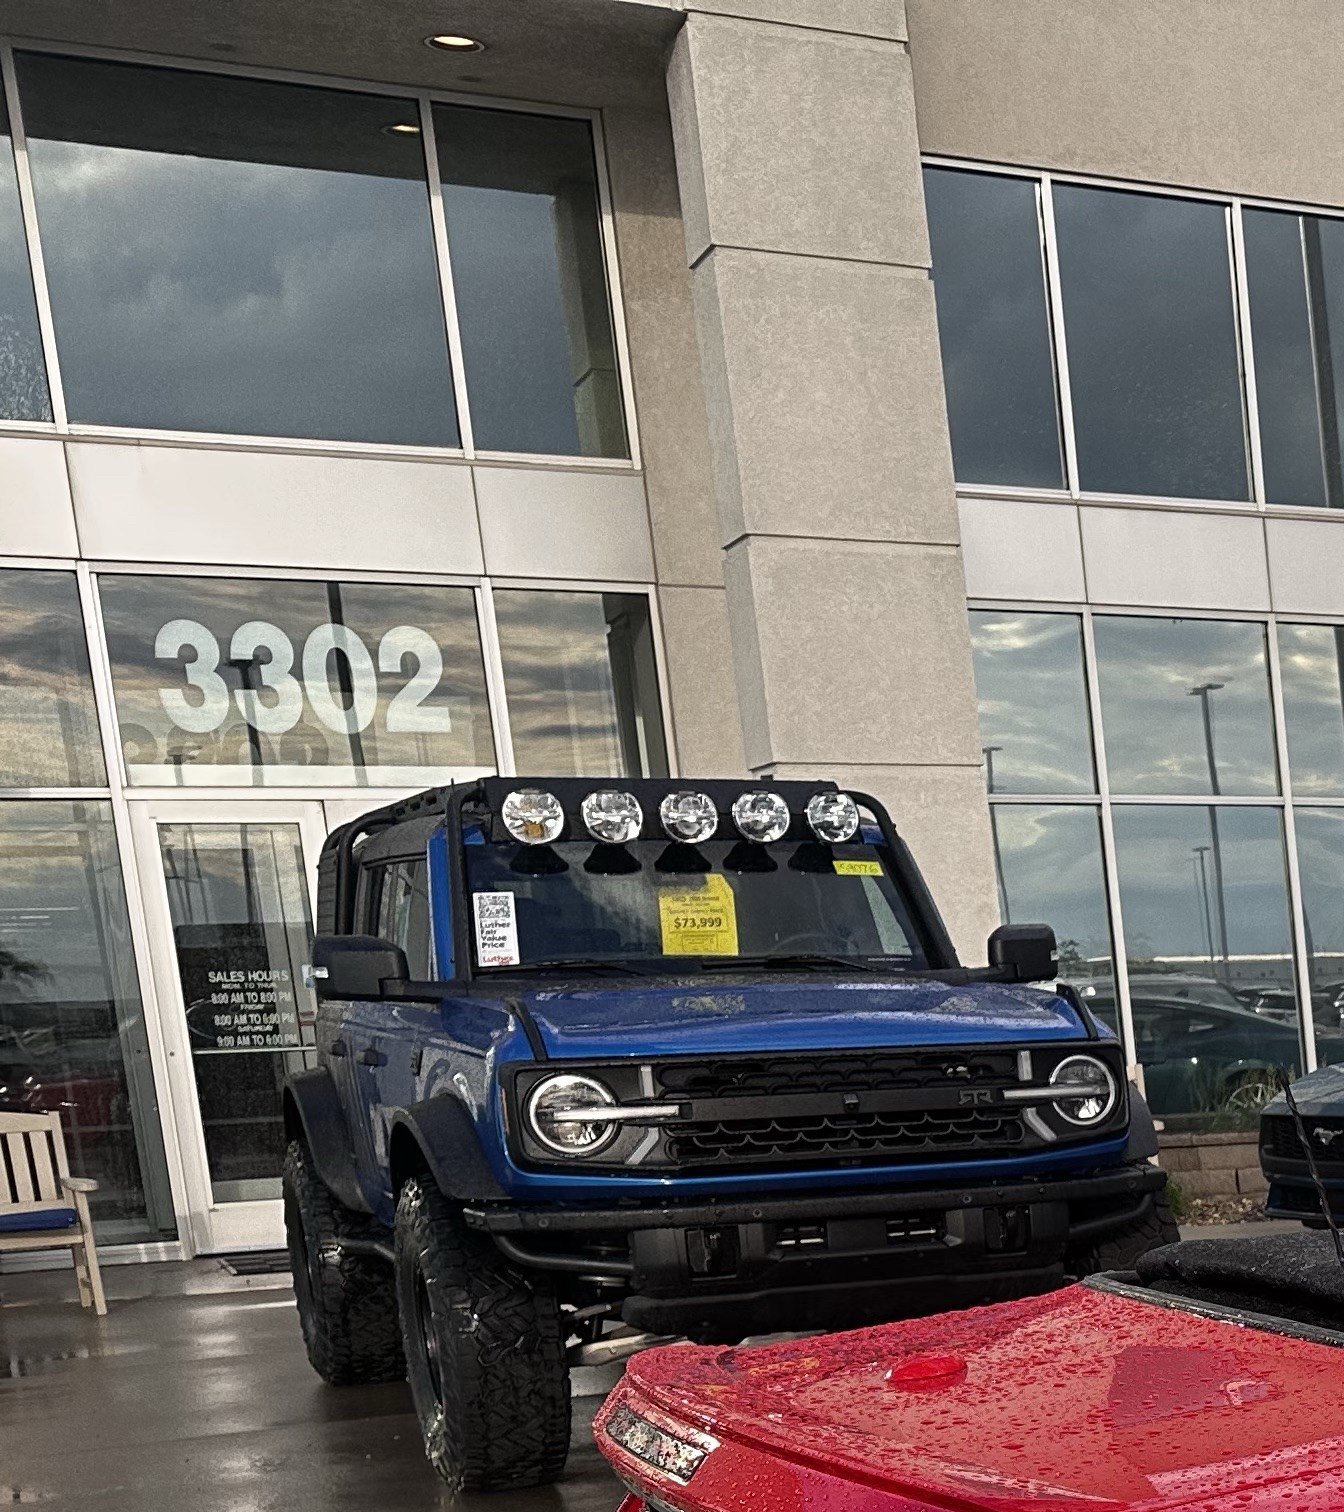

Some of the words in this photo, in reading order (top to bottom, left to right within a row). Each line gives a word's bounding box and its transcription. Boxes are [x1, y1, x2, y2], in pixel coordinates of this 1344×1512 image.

[155, 619, 451, 734] 3302
[208, 970, 245, 983] SALES
[247, 969, 289, 982] HOURS
[230, 992, 244, 1003] AM
[246, 991, 258, 1003] TO
[278, 991, 292, 1002] PM
[233, 1014, 247, 1025] AM
[248, 1013, 261, 1025] TO
[281, 1012, 295, 1023] PM
[236, 1035, 250, 1046] AM
[251, 1035, 264, 1046] TO
[284, 1033, 298, 1044] PM
